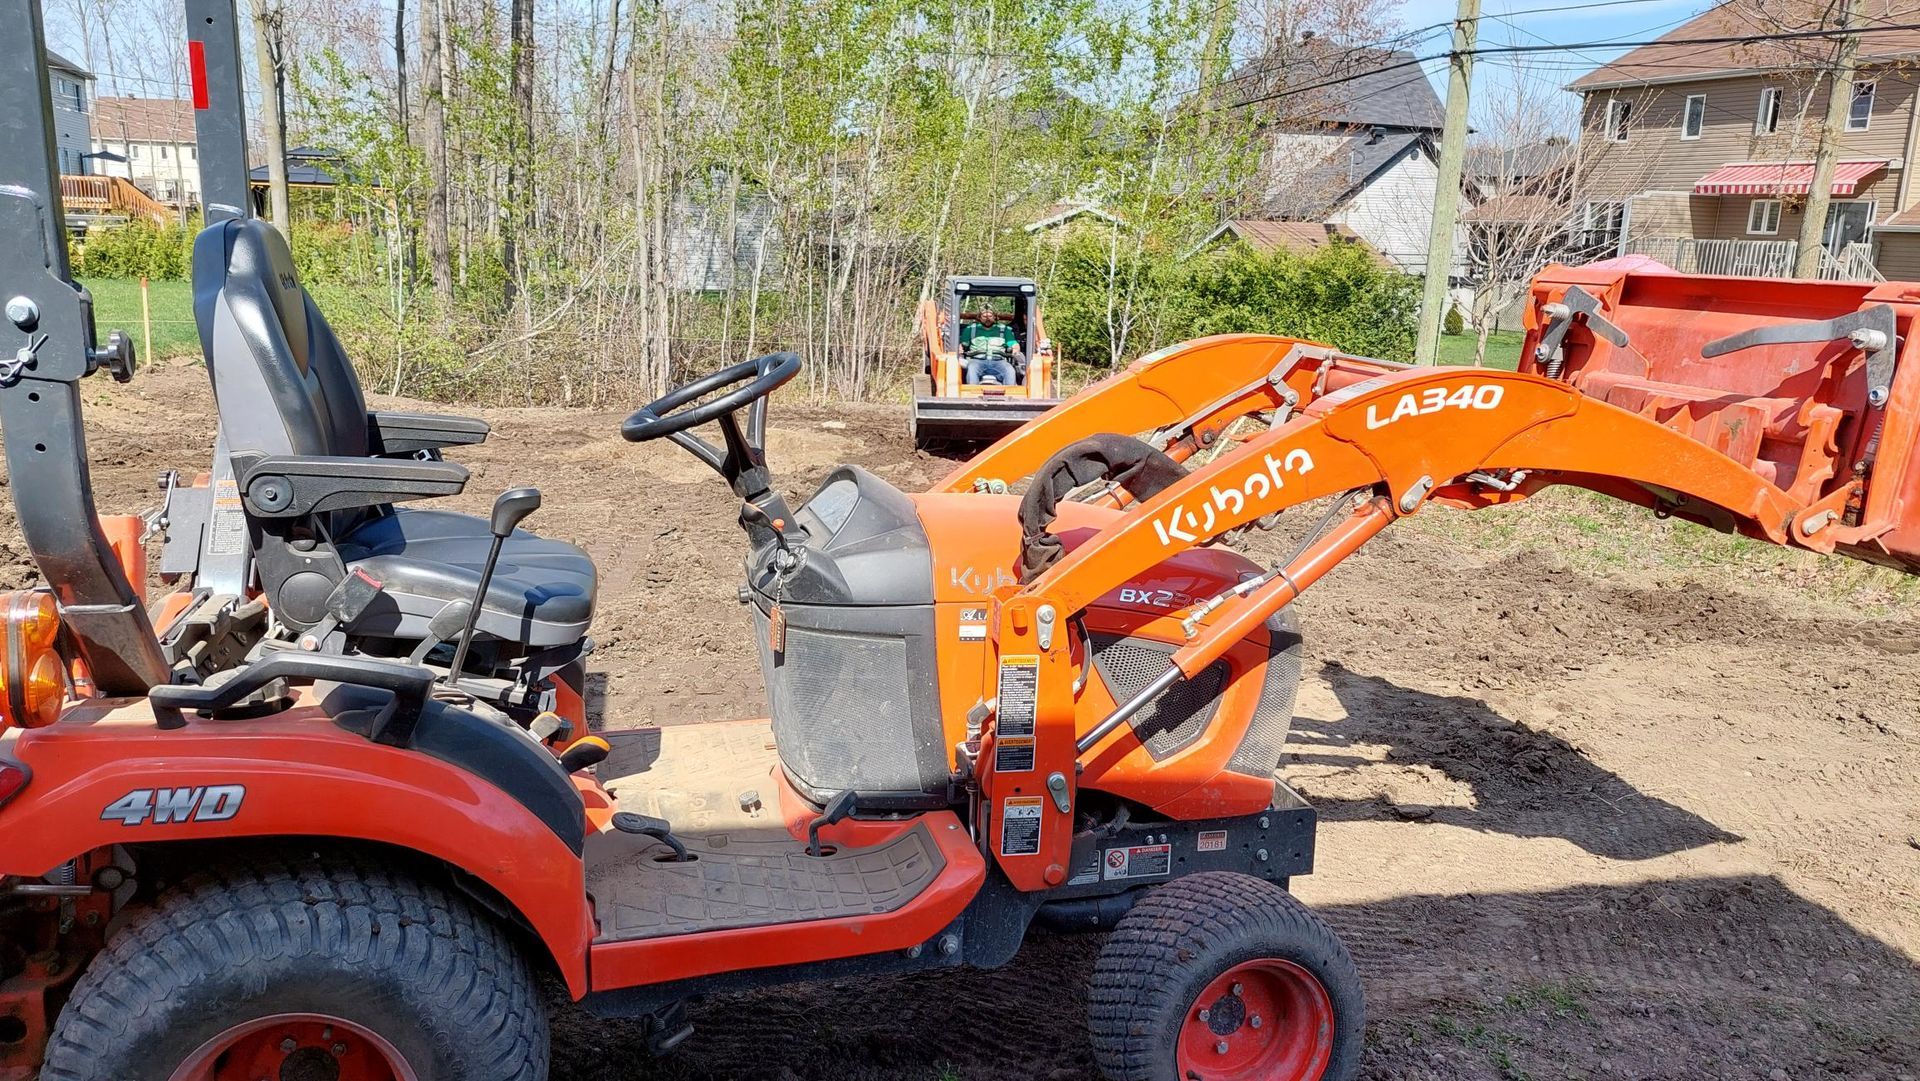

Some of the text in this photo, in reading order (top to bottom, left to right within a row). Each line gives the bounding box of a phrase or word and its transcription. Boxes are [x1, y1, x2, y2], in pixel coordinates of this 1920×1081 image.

[1366, 385, 1505, 430] LA340
[1152, 448, 1315, 546] Kubota
[100, 784, 246, 826] 4WD
